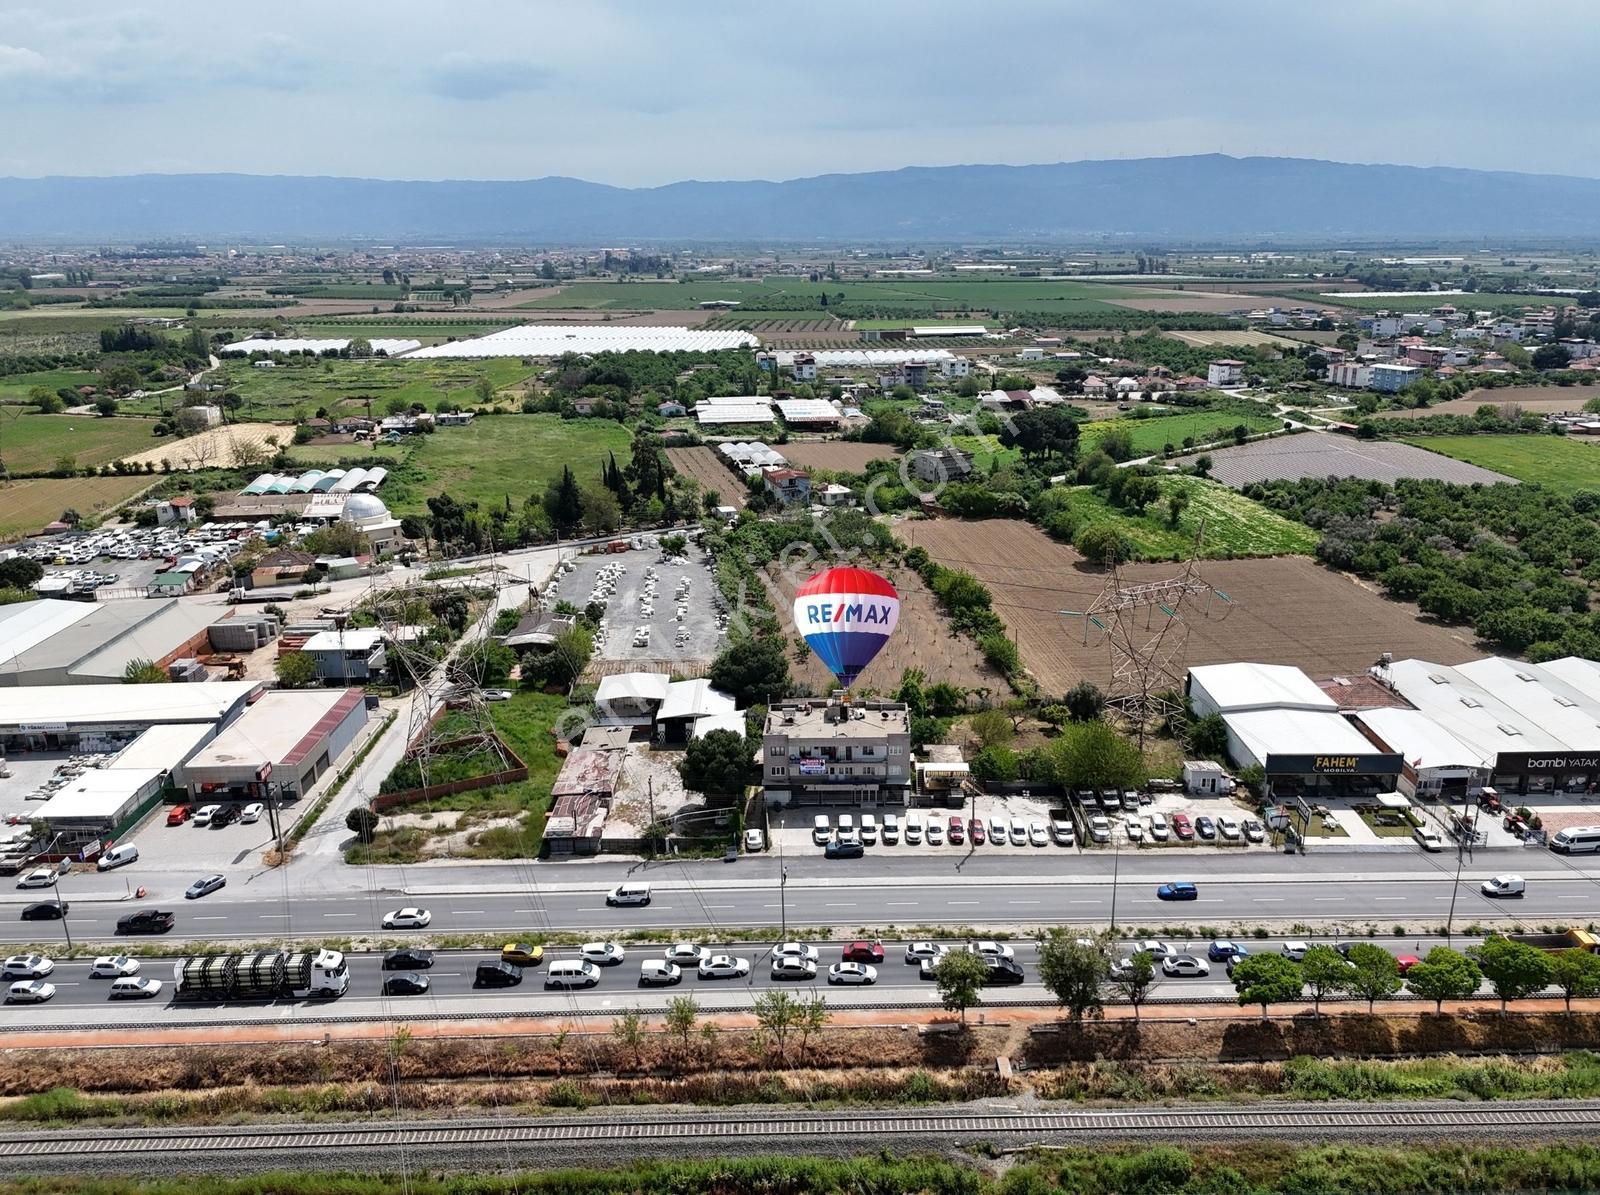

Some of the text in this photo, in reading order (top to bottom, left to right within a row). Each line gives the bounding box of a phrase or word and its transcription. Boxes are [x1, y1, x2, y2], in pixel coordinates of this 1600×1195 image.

[807, 604, 891, 625] RE/MAX
[1316, 757, 1356, 768] FAHEM
[1527, 757, 1599, 768] bambi YATAK
